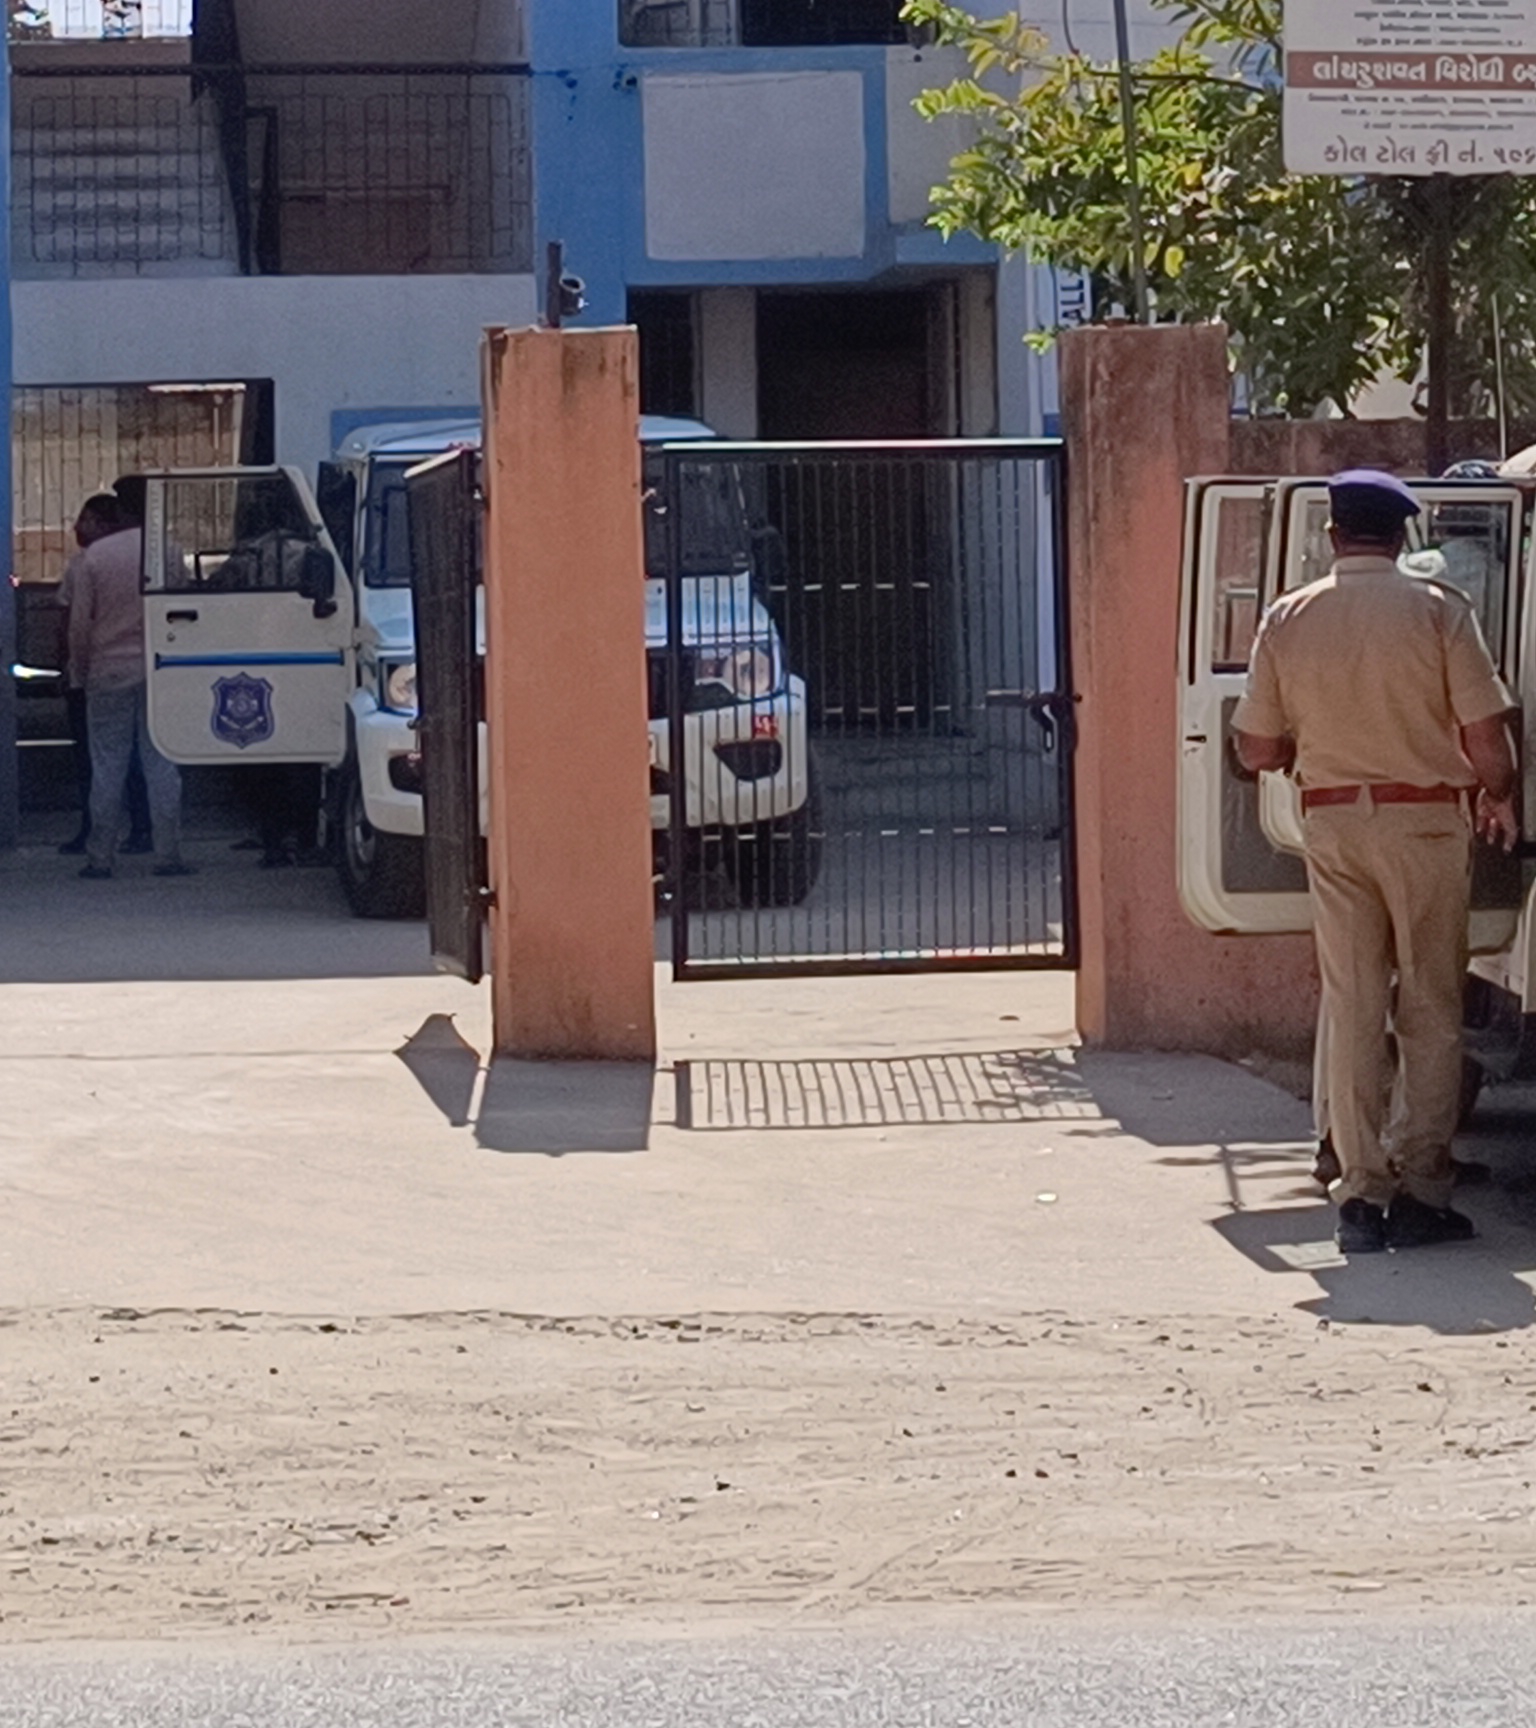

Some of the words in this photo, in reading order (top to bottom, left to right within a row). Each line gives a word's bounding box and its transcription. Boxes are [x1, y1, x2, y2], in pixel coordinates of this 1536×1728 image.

[1435, 54, 1504, 83] વિરોધી
[1323, 135, 1367, 164] કોલ
[1375, 135, 1415, 164] ટોલ
[1458, 139, 1484, 164] નં.
